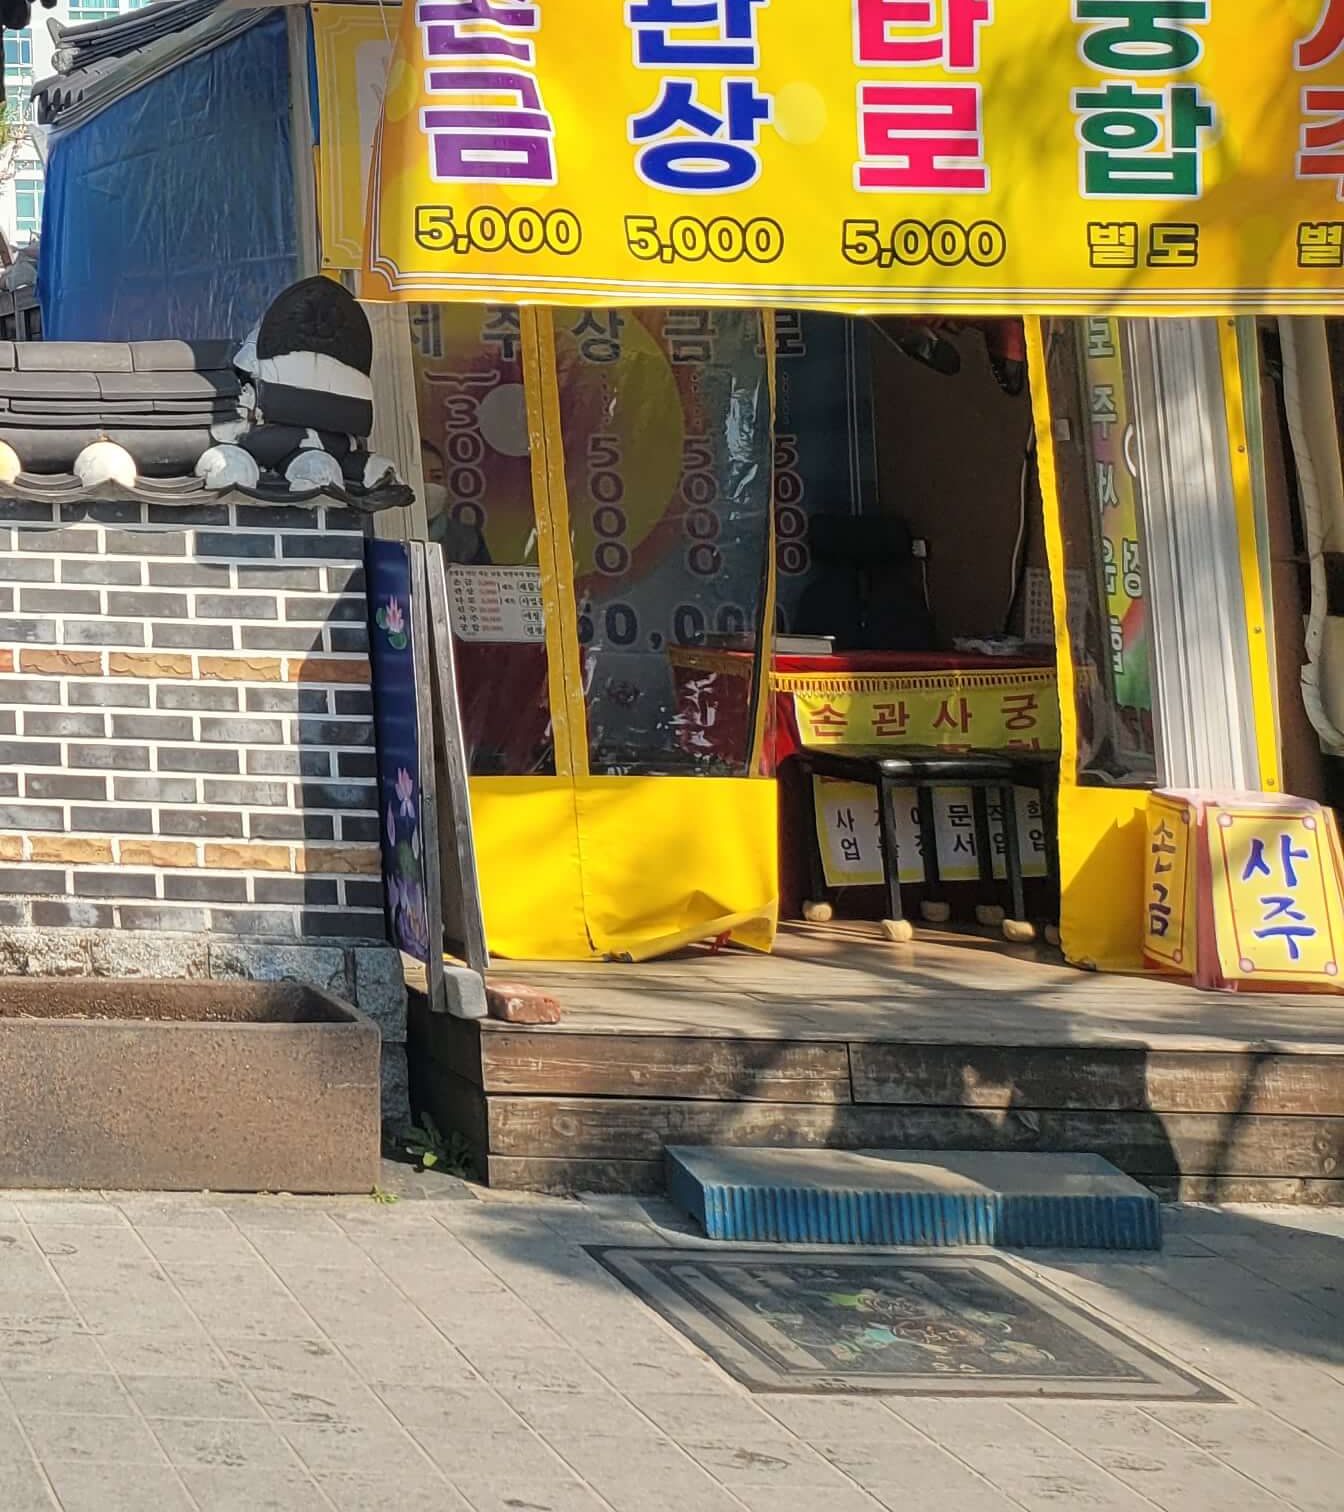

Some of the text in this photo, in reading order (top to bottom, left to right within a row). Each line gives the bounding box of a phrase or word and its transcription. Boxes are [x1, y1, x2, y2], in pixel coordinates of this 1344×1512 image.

[415, 205, 582, 255] 5,000
[625, 215, 784, 263] 5,000
[841, 219, 1006, 268] 5,000
[1149, 818, 1177, 936] 손금
[1242, 834, 1316, 960] 사주
